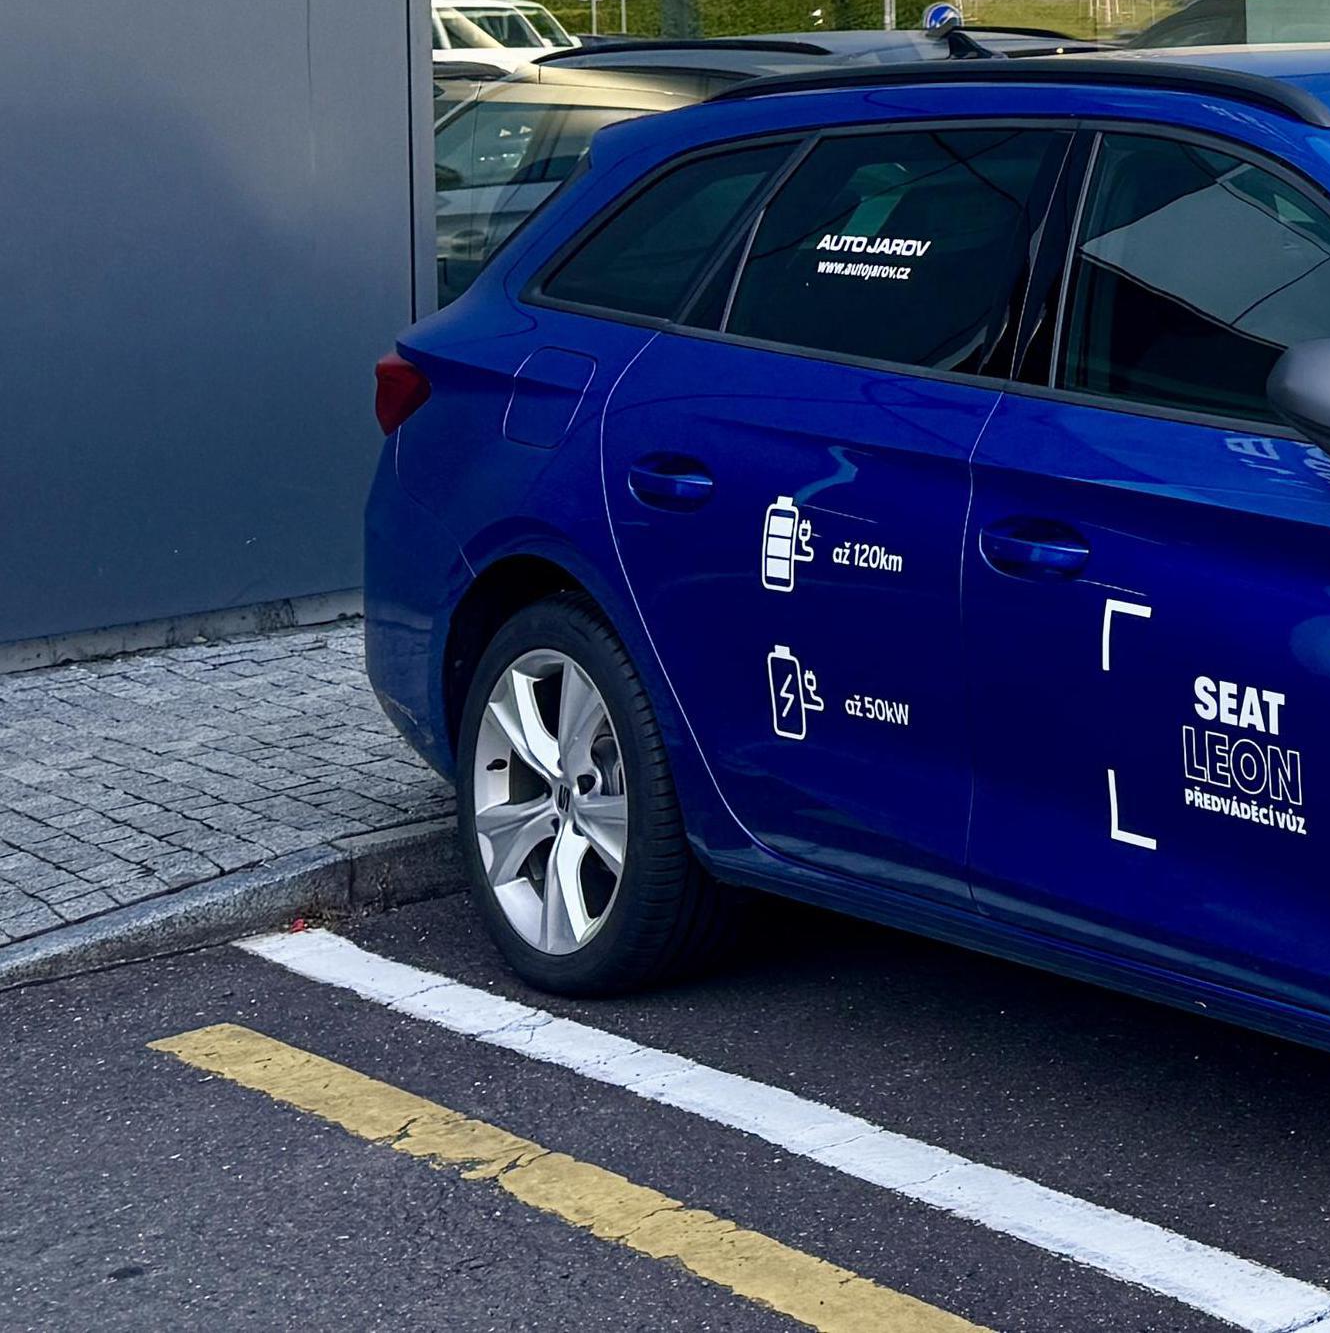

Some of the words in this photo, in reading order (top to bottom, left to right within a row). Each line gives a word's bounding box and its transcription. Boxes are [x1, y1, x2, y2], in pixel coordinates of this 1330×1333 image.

[816, 234, 866, 253] AUTO
[866, 237, 932, 257] JAROV
[816, 260, 911, 280] www.autojarov.cz
[832, 542, 851, 565] až
[853, 543, 903, 573] 120km
[845, 695, 864, 717] až
[864, 697, 909, 726] 50kW
[1193, 675, 1286, 736] SEAT
[1182, 725, 1303, 806] LEON
[1184, 785, 1275, 827] PŘEDVÁDĚCÍ
[1275, 808, 1307, 835] VŮZ
